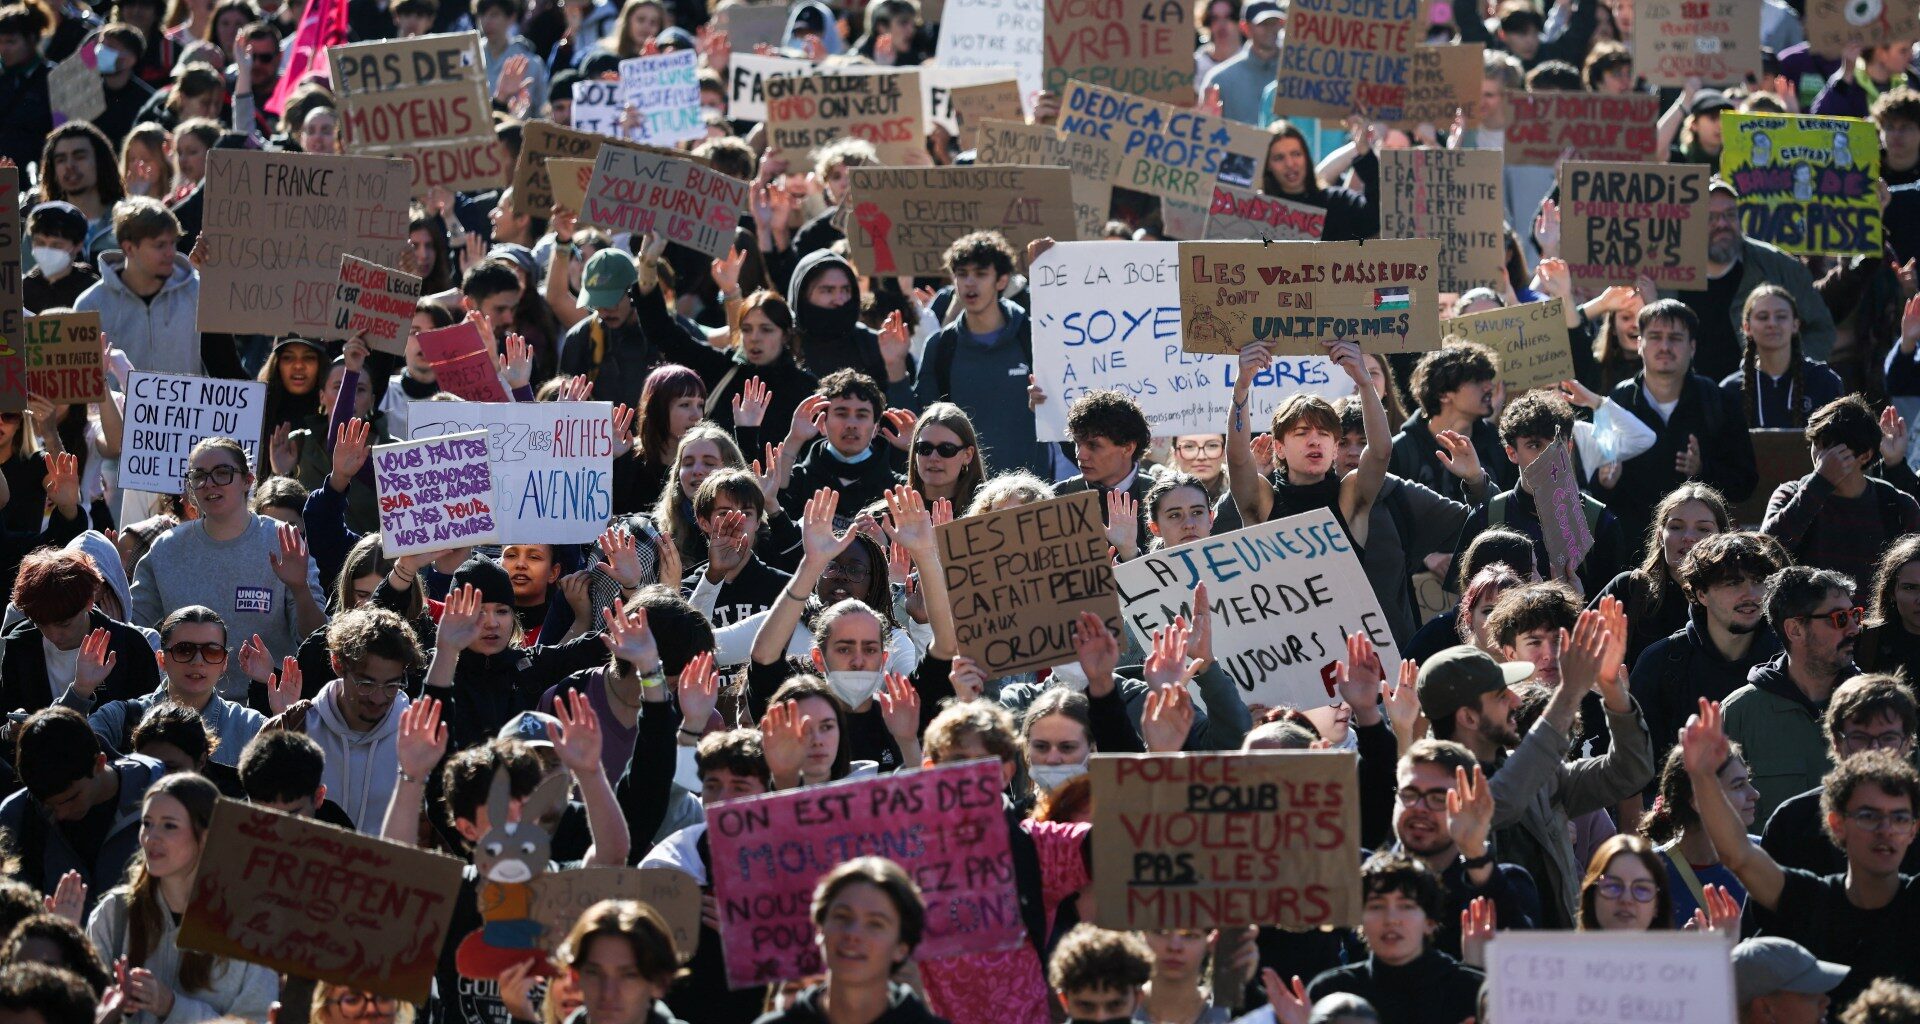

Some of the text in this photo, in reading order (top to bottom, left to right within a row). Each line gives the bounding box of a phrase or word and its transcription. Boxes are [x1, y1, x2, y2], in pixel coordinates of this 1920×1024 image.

[1142, 1, 1184, 23] LA
[338, 50, 464, 97] PAS DE
[1375, 56, 1410, 84] UNE
[344, 97, 473, 144] MOYENS
[1124, 130, 1220, 174] PROFS
[210, 158, 252, 196] MA
[264, 163, 335, 198] FRANCE
[602, 151, 743, 207] IF WE BURN
[852, 170, 918, 190] QUAND
[1132, 158, 1200, 197] BRRR
[598, 175, 705, 220] YOU BURN
[1574, 200, 1691, 220] POUR LES UNS
[206, 200, 252, 230] LEUR
[590, 198, 656, 234] WITH
[667, 214, 695, 242] US
[1587, 216, 1682, 248] PAS UN
[1039, 258, 1180, 287] DE LA BOÉT
[1192, 255, 1246, 285] LES
[1331, 260, 1429, 285] CASSEURS
[1607, 264, 1638, 280] LES
[228, 281, 285, 314] NOUS
[1216, 287, 1313, 310] SONT EN
[66, 326, 97, 343] VOS
[335, 307, 350, 330] LA
[1252, 312, 1410, 341] UNIFORMES
[1063, 351, 1128, 383] À NE
[1224, 360, 1331, 389] LBRES
[135, 377, 250, 409] C'EST NOUS
[134, 403, 238, 434] ON FAIT DU
[132, 429, 183, 454] BRUIT
[377, 437, 488, 473] VOUS FAITES
[128, 455, 161, 477] QUE
[377, 472, 414, 495] DES
[380, 492, 415, 513] SUR
[413, 485, 444, 506] NOS
[382, 497, 491, 532] ET PAS POUR
[394, 514, 496, 547] NOS AVENIRS
[945, 498, 1093, 561] LES FEUX
[945, 537, 1107, 591] DE POUBELLE
[1116, 521, 1350, 607] LA JEUNESSE
[237, 590, 271, 600] UNION
[1050, 564, 1115, 604] PEUR
[238, 600, 270, 610] PIRATE
[956, 612, 1018, 644] QU'AUX
[984, 616, 1122, 669] ORDURS
[1116, 756, 1240, 786] POLICE
[718, 774, 998, 837] ON EST PAS DES
[1286, 780, 1344, 808] LES
[1119, 811, 1346, 853] VIOLEURS
[965, 853, 1014, 886] PAS
[1132, 852, 1281, 884] PAS LES
[242, 845, 446, 926] FRAPPENT
[1126, 884, 1332, 929] MINEURS
[751, 925, 814, 950] POU
[1503, 955, 1699, 984] C'EST NOUS ON
[1506, 987, 1690, 1020] FAIT DU BRUIT
